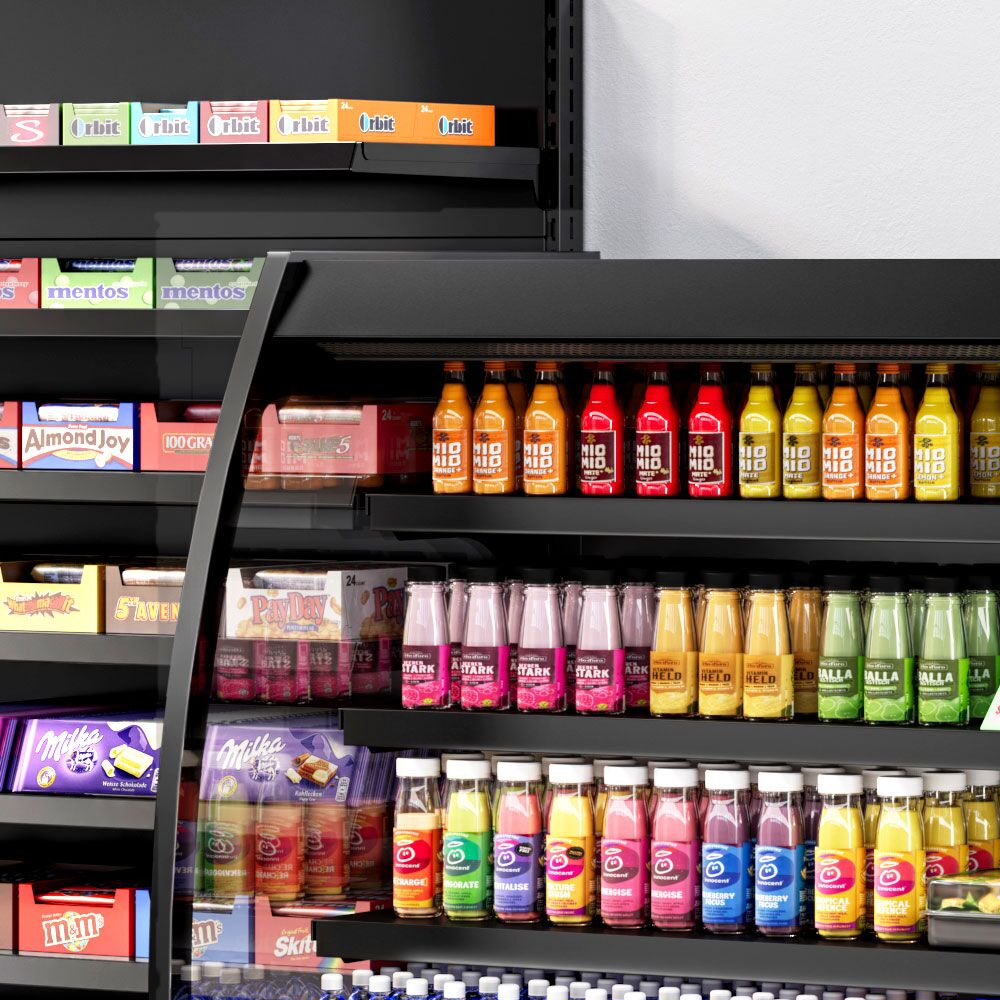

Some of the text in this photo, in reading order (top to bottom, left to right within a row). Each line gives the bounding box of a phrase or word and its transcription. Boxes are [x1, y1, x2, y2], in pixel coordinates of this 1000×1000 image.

[71, 117, 121, 138] Orbit
[139, 117, 190, 138] Orbit
[208, 115, 260, 137] Orbit
[278, 114, 329, 135] Orbit
[360, 112, 395, 133] Orbit
[438, 115, 473, 135] Orbit
[47, 283, 129, 299] mentos
[161, 283, 245, 300] mentos
[25, 429, 131, 454] Almond Joy
[165, 435, 212, 449] 100 GRA
[346, 575, 356, 586] 24
[135, 602, 179, 621] AVEN
[250, 592, 330, 628] PayDay
[652, 672, 682, 681] HELD
[701, 673, 731, 682] HELD
[746, 675, 776, 684] HELD
[35, 725, 103, 761] Milka
[216, 733, 286, 769] Milka
